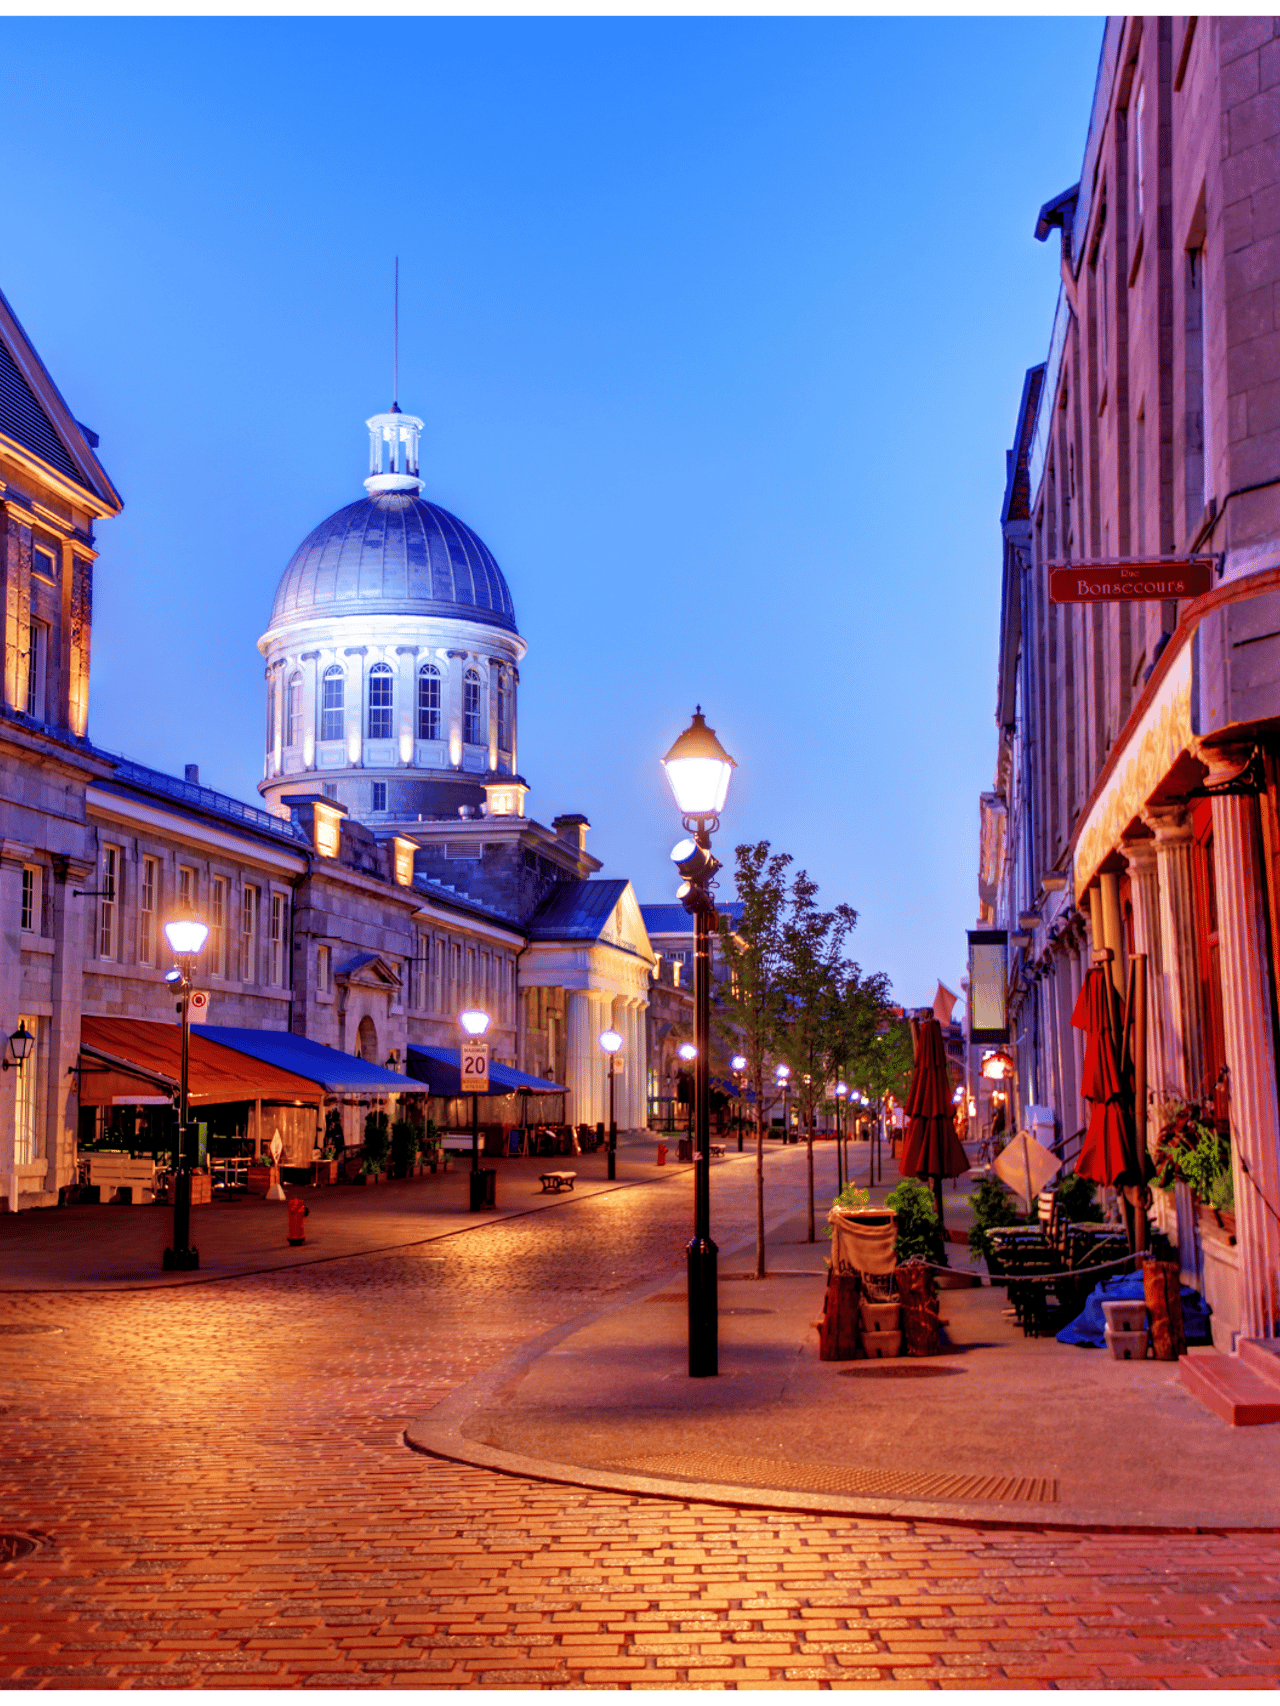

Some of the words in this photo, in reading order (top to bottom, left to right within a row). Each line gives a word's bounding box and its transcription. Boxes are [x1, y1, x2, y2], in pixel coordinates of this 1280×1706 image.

[1121, 569, 1140, 578] Rue
[1077, 579, 1184, 595] Bonsecours
[465, 1056, 485, 1074] 20
